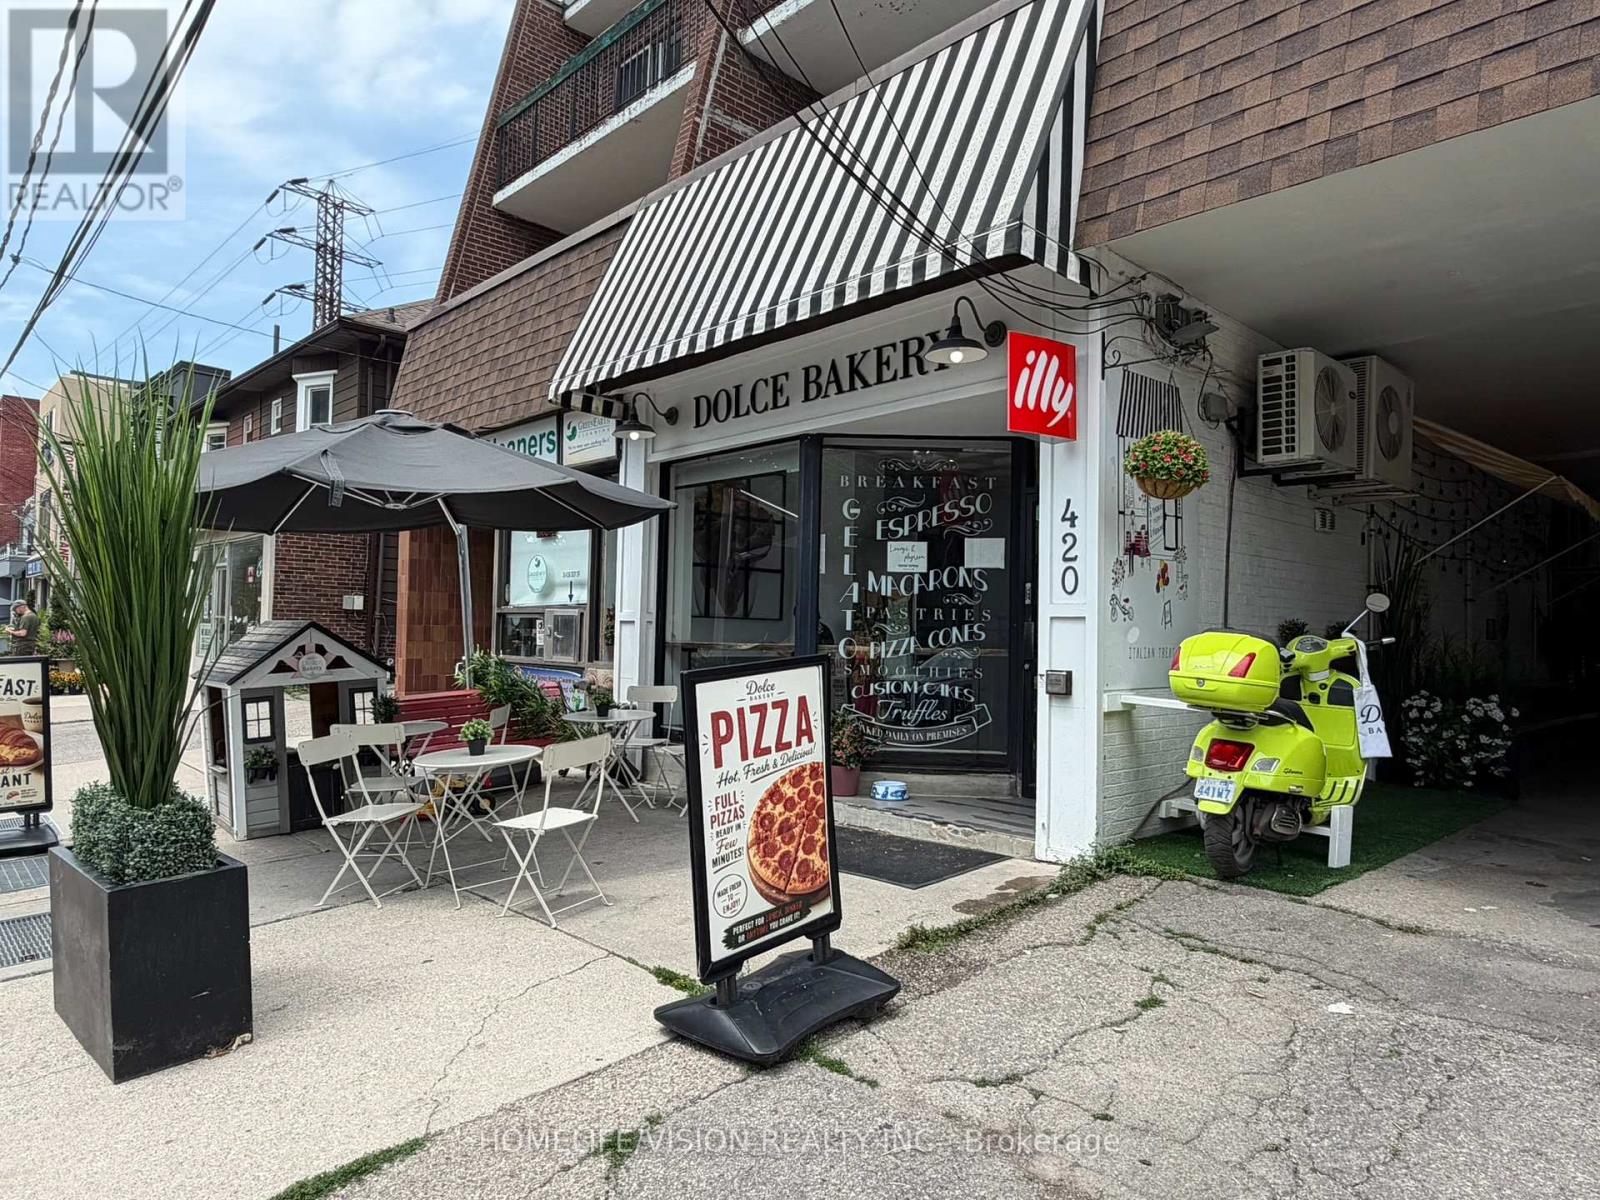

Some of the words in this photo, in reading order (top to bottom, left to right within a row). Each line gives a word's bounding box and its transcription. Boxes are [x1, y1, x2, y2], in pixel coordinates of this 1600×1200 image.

[1014, 350, 1074, 428] illy
[693, 372, 790, 429] DOLCE
[840, 475, 997, 489] BREAKFAST
[876, 493, 993, 541] ESPRESSO
[1061, 498, 1079, 595] 420
[868, 566, 988, 597] MACARONS
[866, 607, 991, 622] PASTRIES
[870, 636, 922, 659] PIZZA
[928, 623, 986, 649] CONES
[1129, 647, 1155, 660] ITALIAN
[844, 665, 983, 680] SMOOTHIES
[746, 678, 776, 696] Dolce
[749, 692, 774, 701] BAKERY
[851, 680, 918, 699] CUSTOM
[921, 682, 975, 702] CAKES
[877, 699, 948, 726] Truffles
[710, 695, 815, 769] PIZZA
[912, 733, 924, 741] ON
[926, 728, 967, 741] PREMISES
[716, 770, 741, 789] Hot,
[742, 759, 770, 781] Fresh
[772, 759, 778, 768] &
[780, 742, 817, 767] Delicious!
[714, 790, 740, 811] FULL
[710, 805, 745, 829] PIZZAS
[715, 826, 734, 839] READY
[735, 824, 742, 833] IN
[715, 837, 739, 855] Few
[712, 847, 744, 869] MINUTES!
[717, 887, 729, 898] MADE
[727, 893, 734, 902] TO
[722, 898, 741, 914] ENJOY!
[732, 921, 754, 935] PERFECT
[755, 916, 765, 926] FOR
[738, 934, 746, 943] OR
[769, 921, 779, 930] YOU
[779, 914, 794, 924] CRAVE
